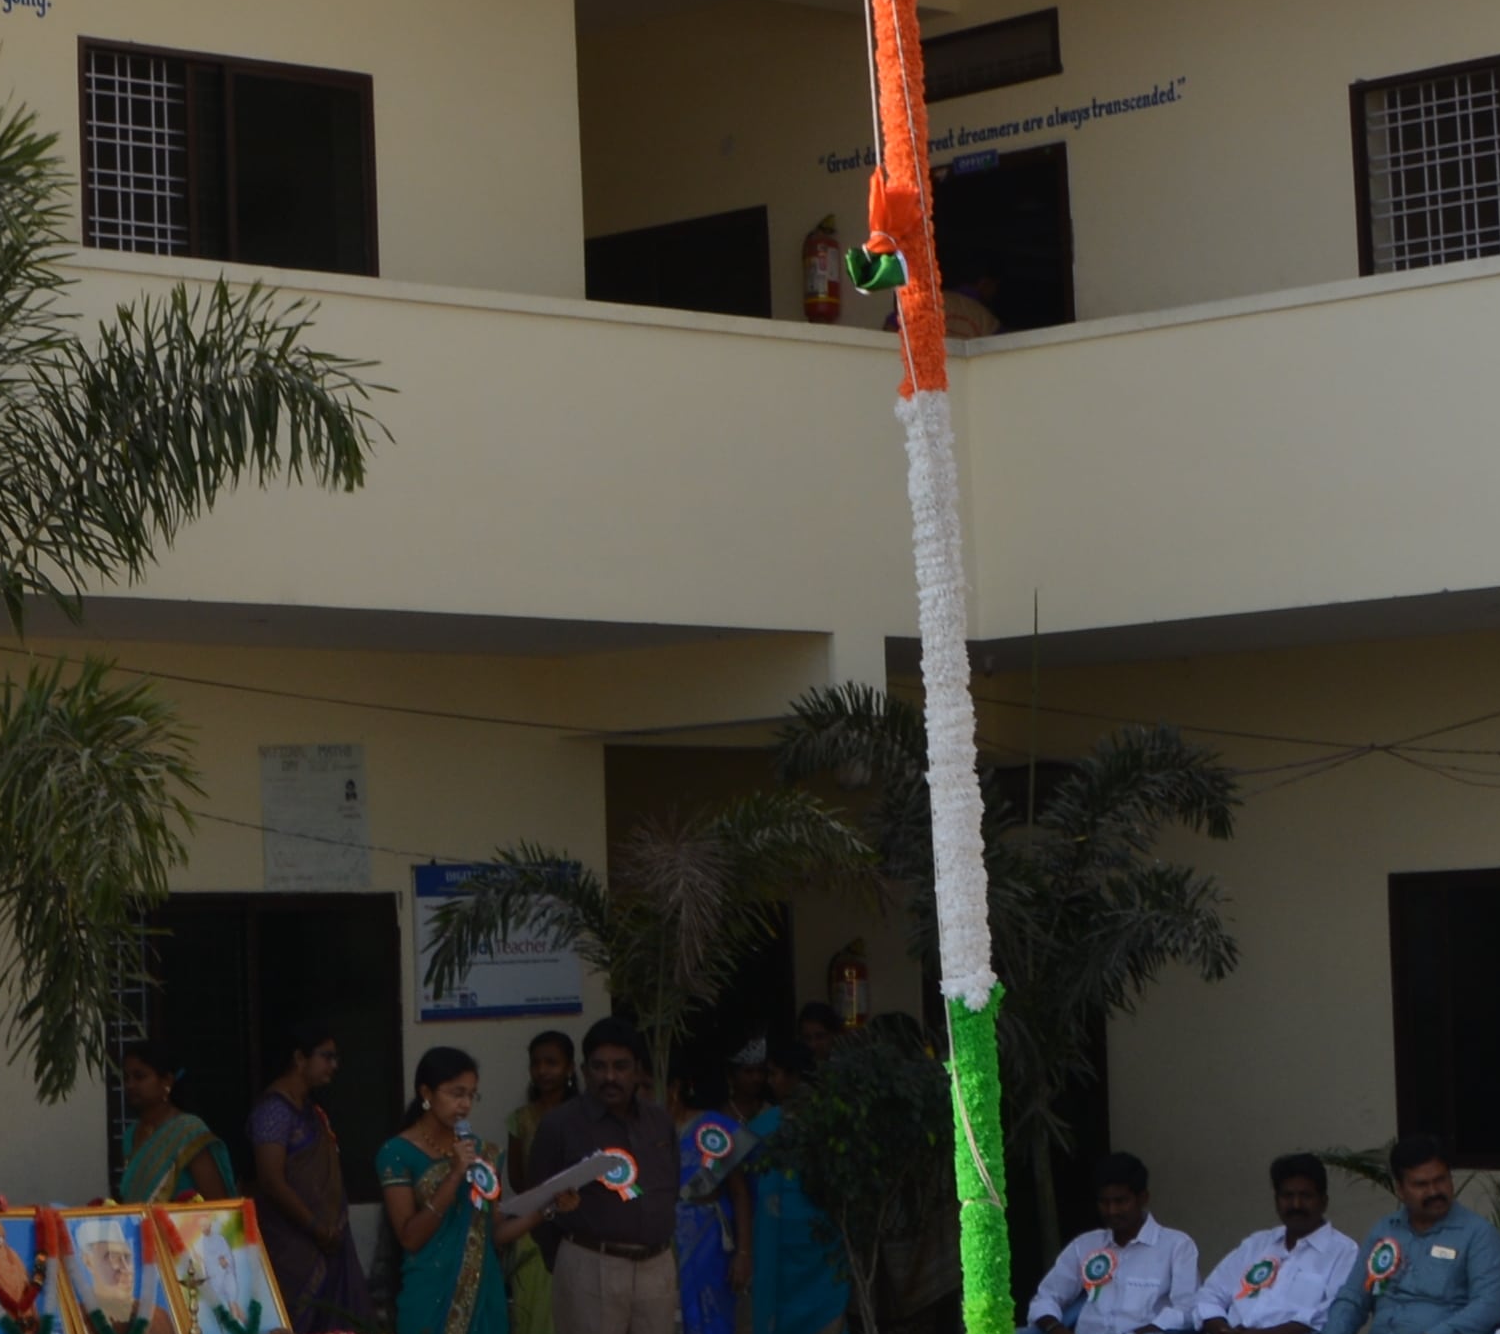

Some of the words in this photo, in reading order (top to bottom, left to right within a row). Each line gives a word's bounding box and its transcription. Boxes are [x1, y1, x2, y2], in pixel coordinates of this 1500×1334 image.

[927, 128, 955, 154] reat
[957, 121, 1020, 147] dreamers
[1022, 116, 1044, 133] are
[1046, 104, 1091, 130] always
